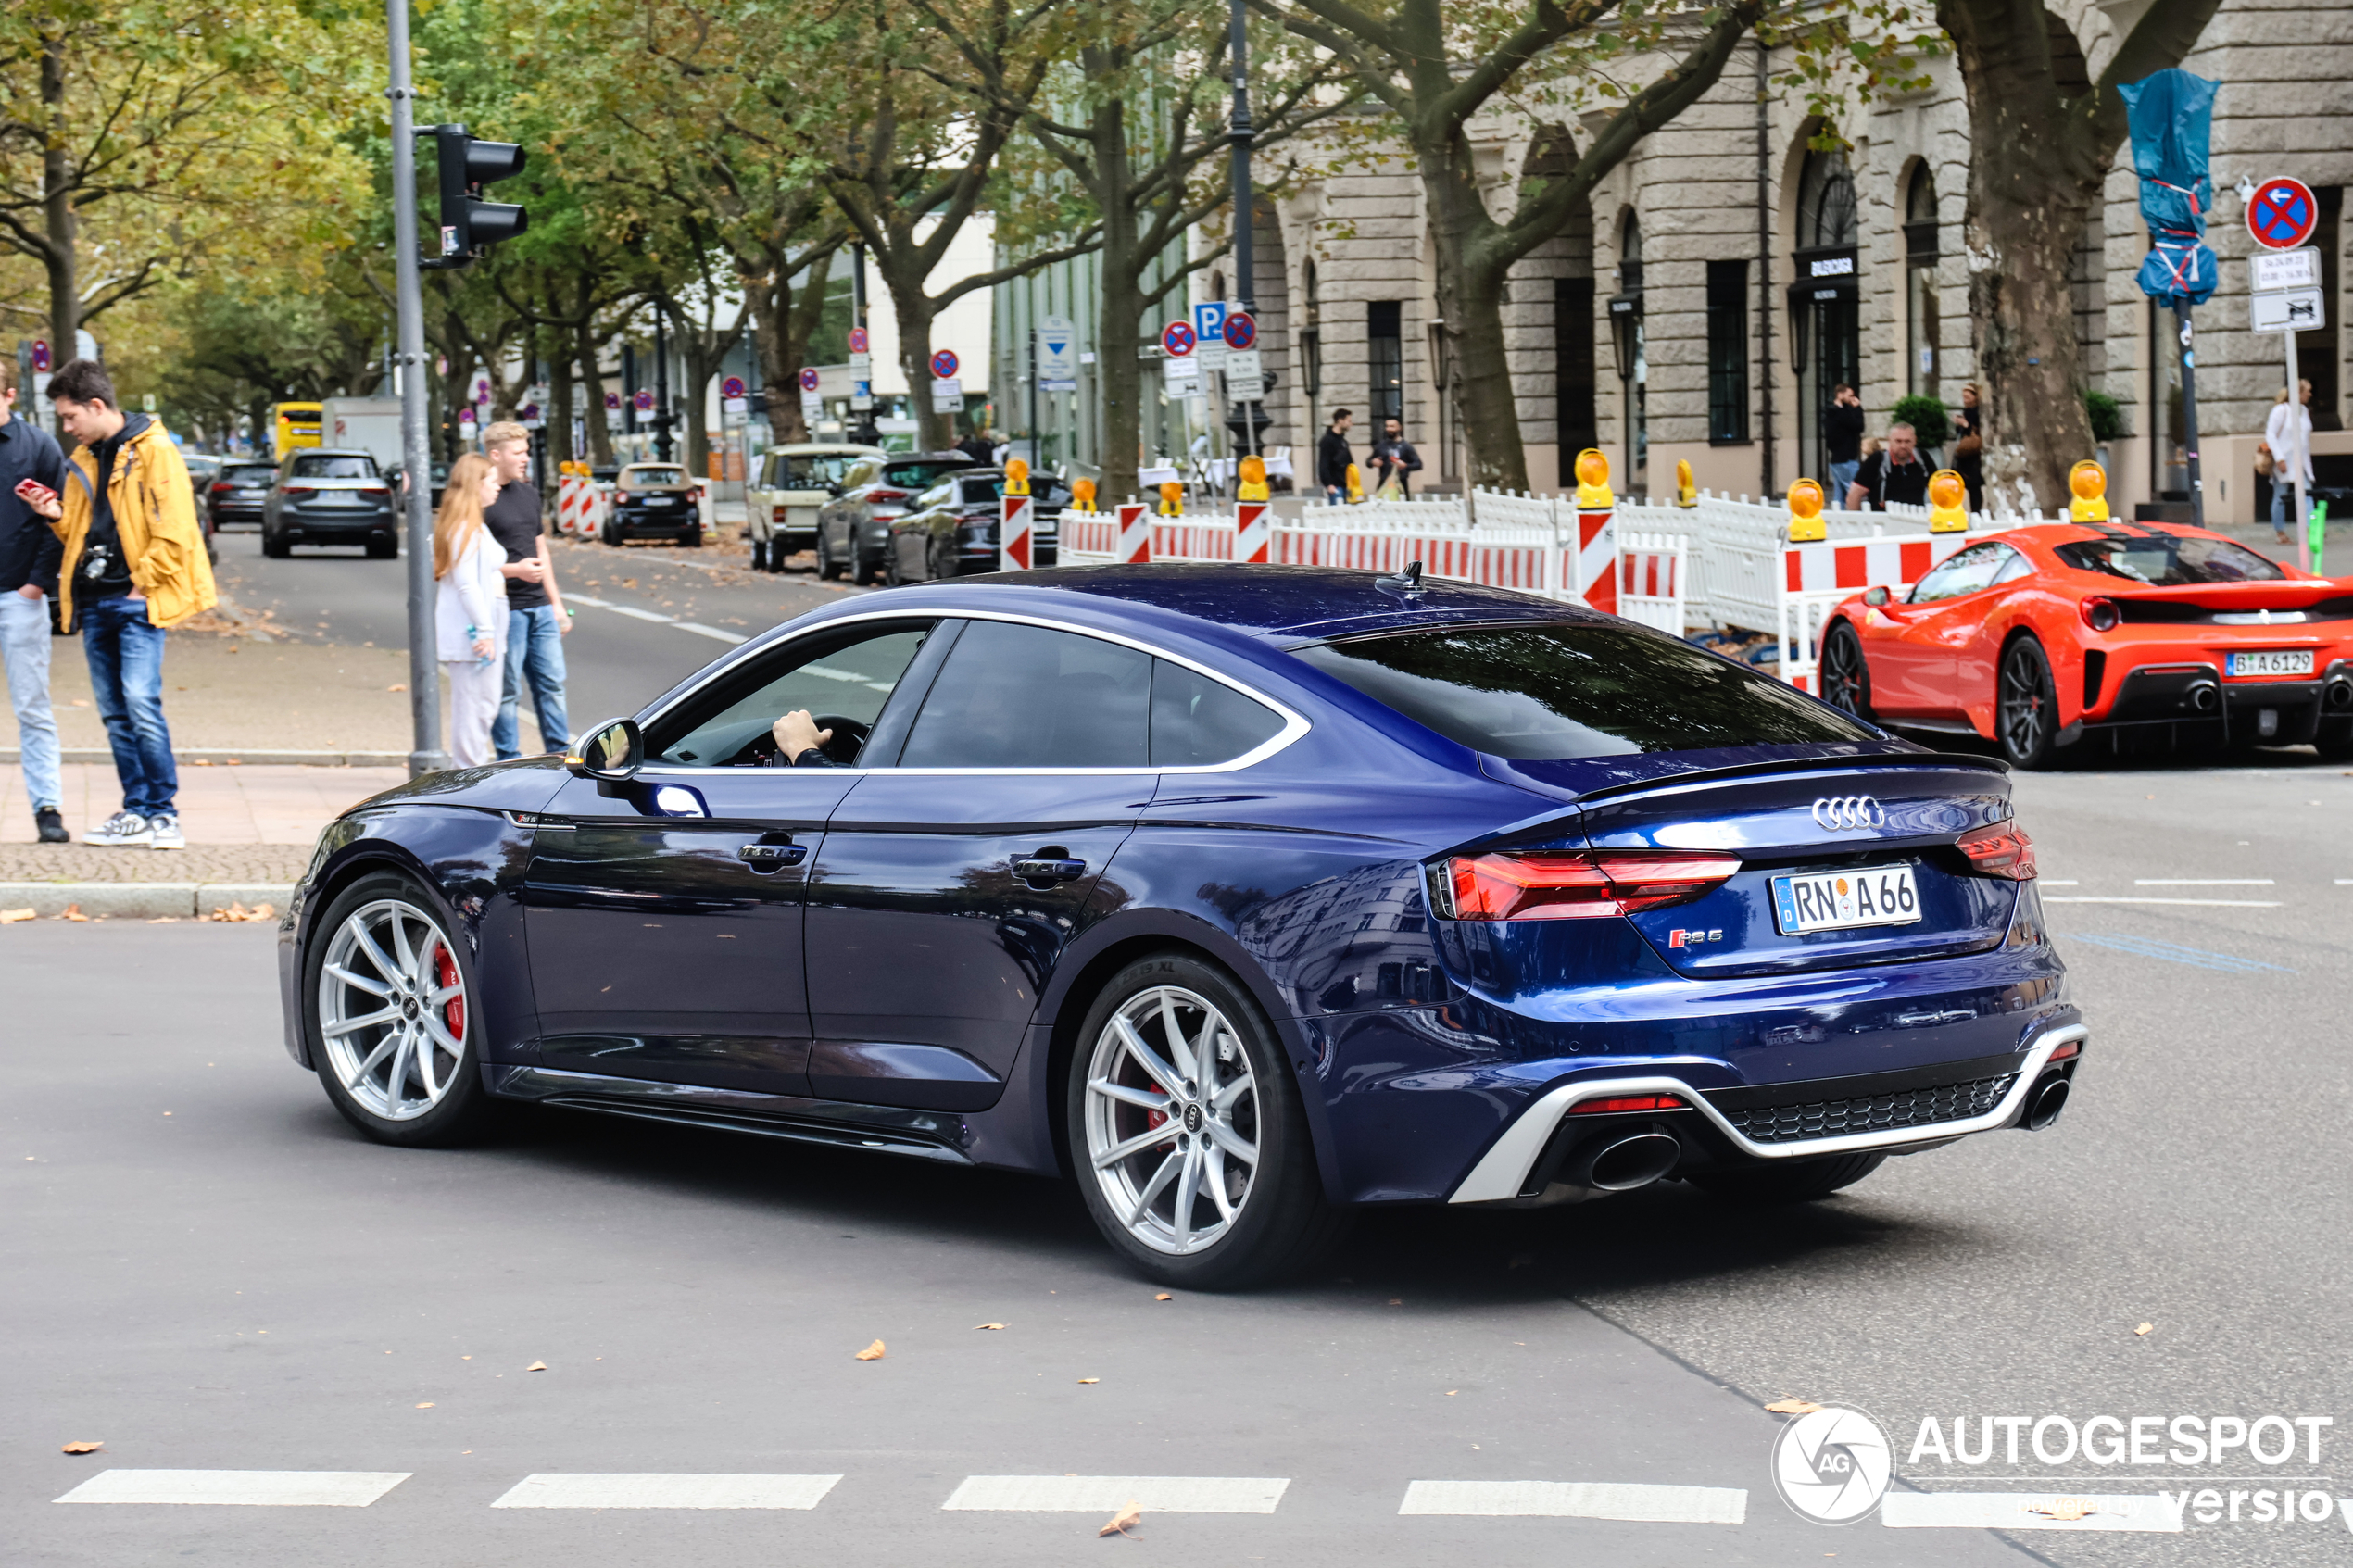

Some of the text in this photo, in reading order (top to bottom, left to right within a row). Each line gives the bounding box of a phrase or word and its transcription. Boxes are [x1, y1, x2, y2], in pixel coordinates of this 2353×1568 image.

[1201, 307, 1220, 337] P
[2236, 654, 2310, 671] B A 6129
[1793, 880, 1838, 922] RN
[1783, 909, 1793, 922] D
[1158, 961, 1175, 972] XL
